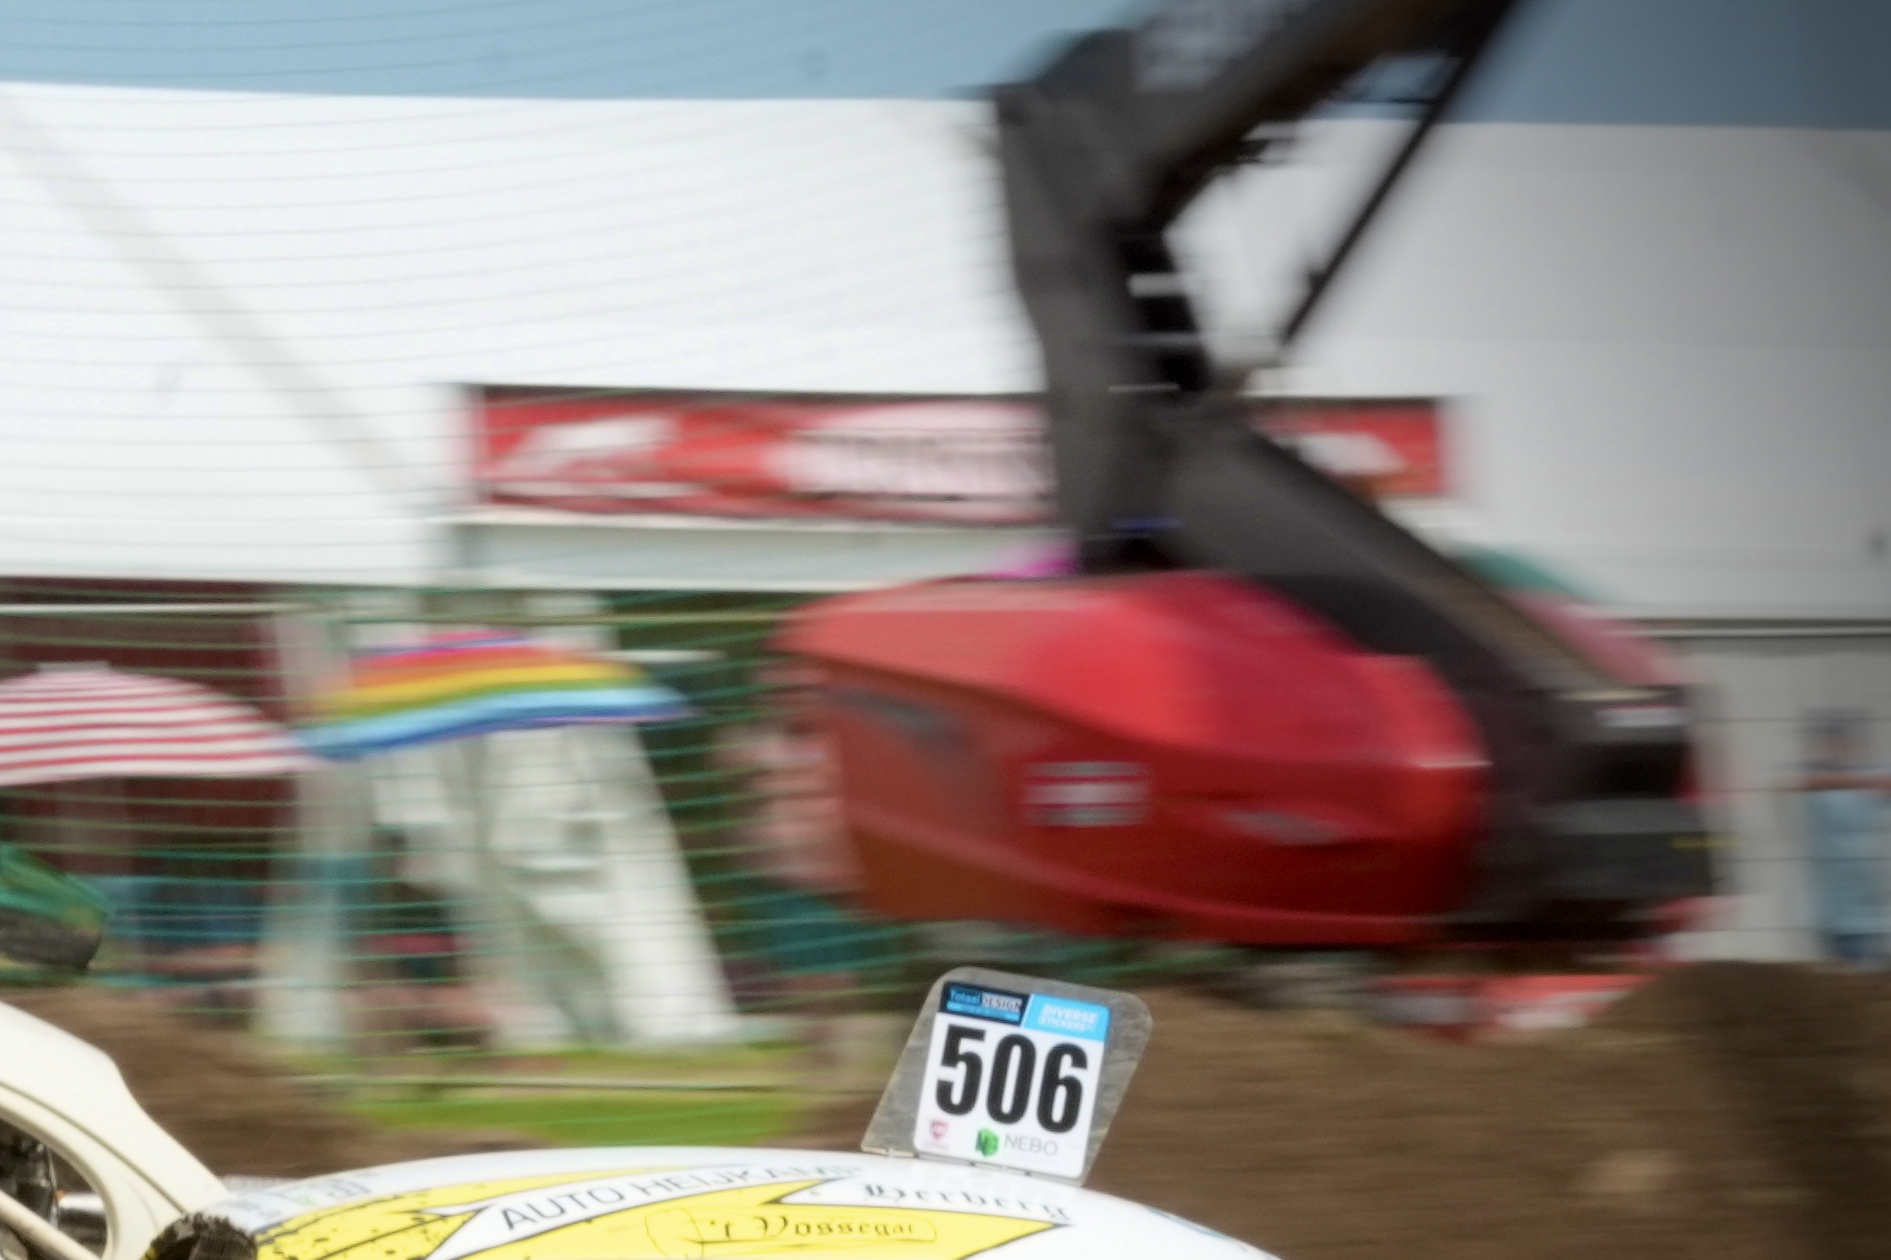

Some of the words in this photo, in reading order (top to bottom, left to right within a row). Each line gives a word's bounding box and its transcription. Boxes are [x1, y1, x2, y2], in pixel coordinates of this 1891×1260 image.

[1042, 1003, 1100, 1023] DIVERSE
[935, 1023, 1088, 1134] 506
[1003, 1133, 1059, 1157] NEBO
[500, 1185, 627, 1231] AUTO
